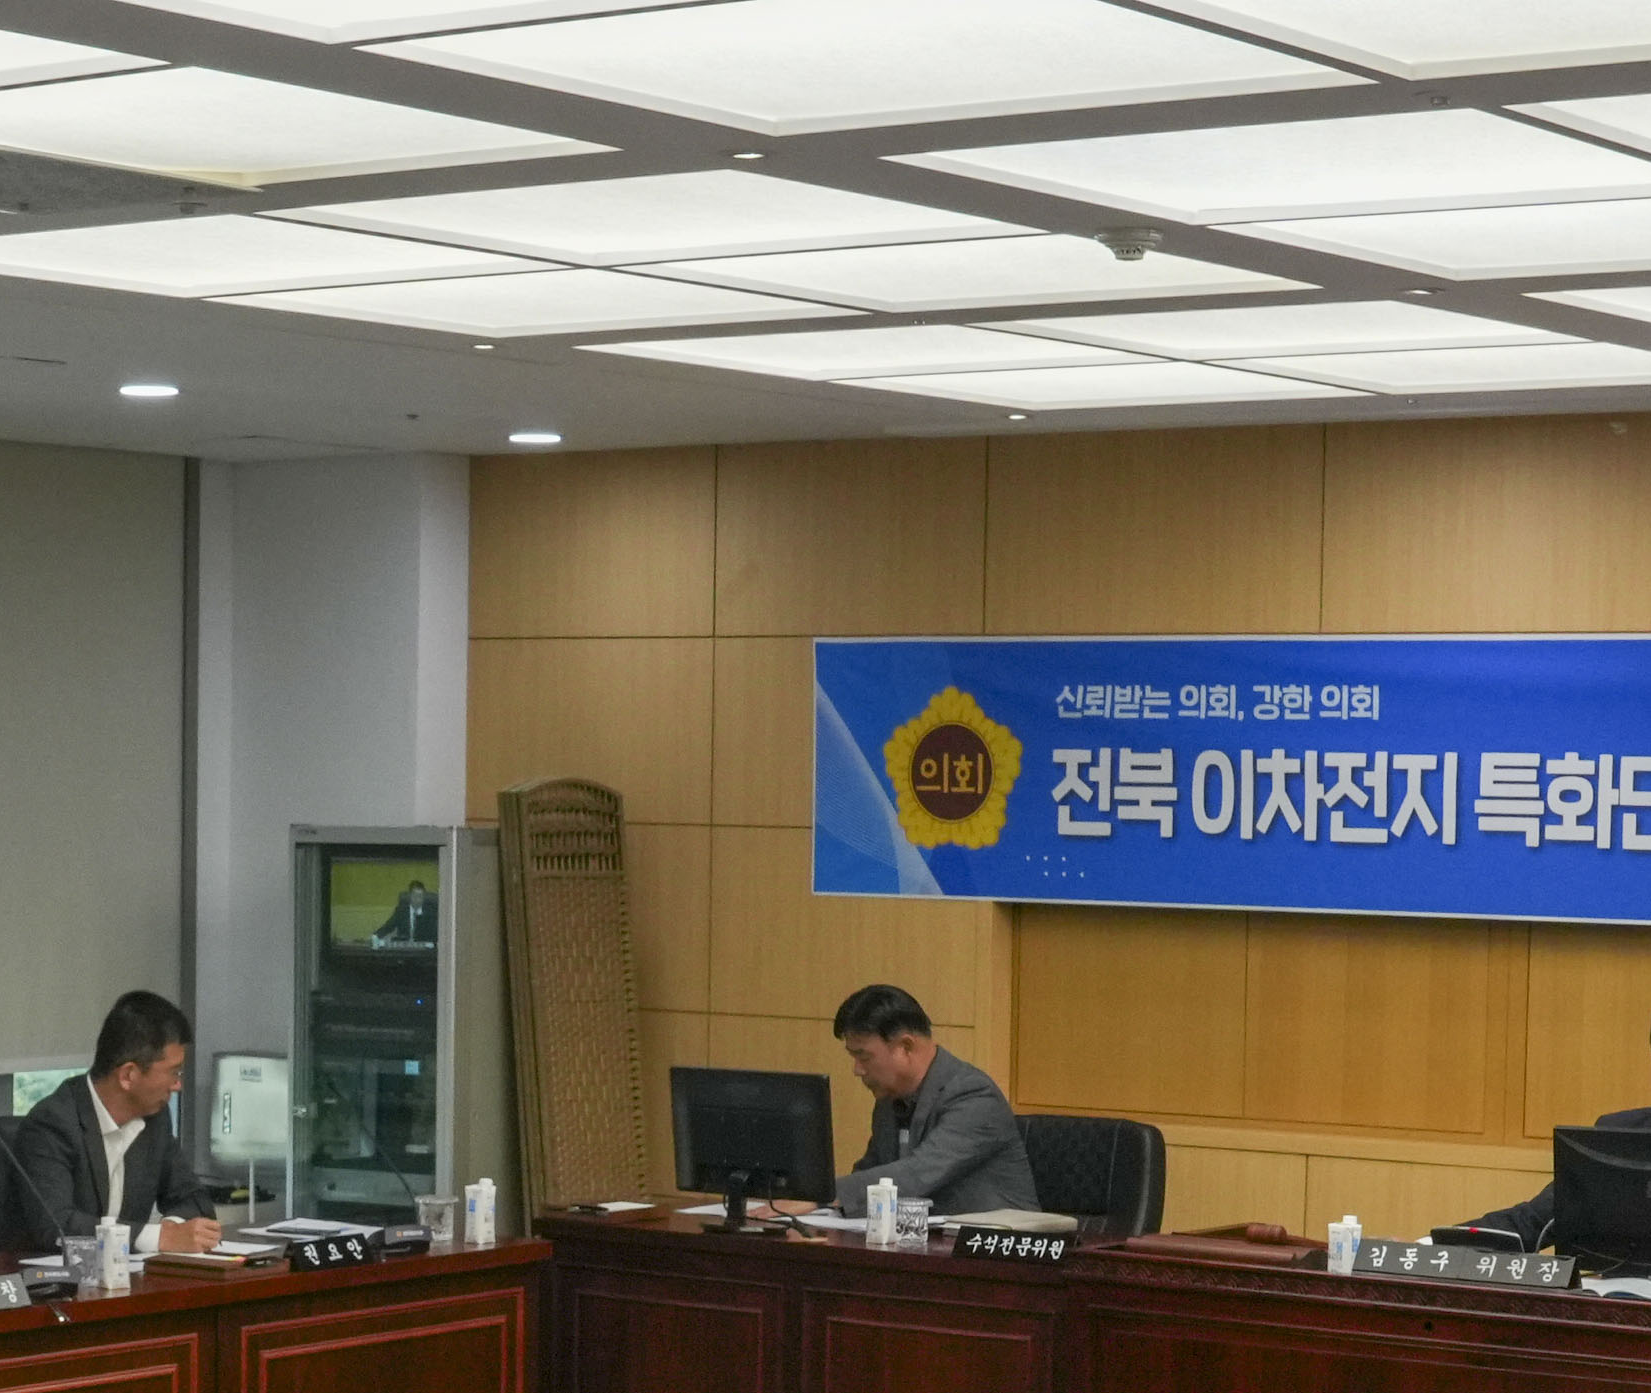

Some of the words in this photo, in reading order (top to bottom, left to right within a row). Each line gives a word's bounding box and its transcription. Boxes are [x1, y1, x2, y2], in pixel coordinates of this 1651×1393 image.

[1055, 684, 1172, 720] 신뢰받는
[1178, 684, 1245, 722] 의회,
[1252, 684, 1313, 721] 강한
[1319, 685, 1381, 721] 의회
[915, 752, 983, 794] 의회
[1051, 747, 1178, 839] 전북
[1191, 750, 1458, 846] 이차전지
[966, 1232, 1065, 1260] 수석전문위원
[1369, 1245, 1450, 1273] 김동구
[1476, 1254, 1560, 1282] 위원장
